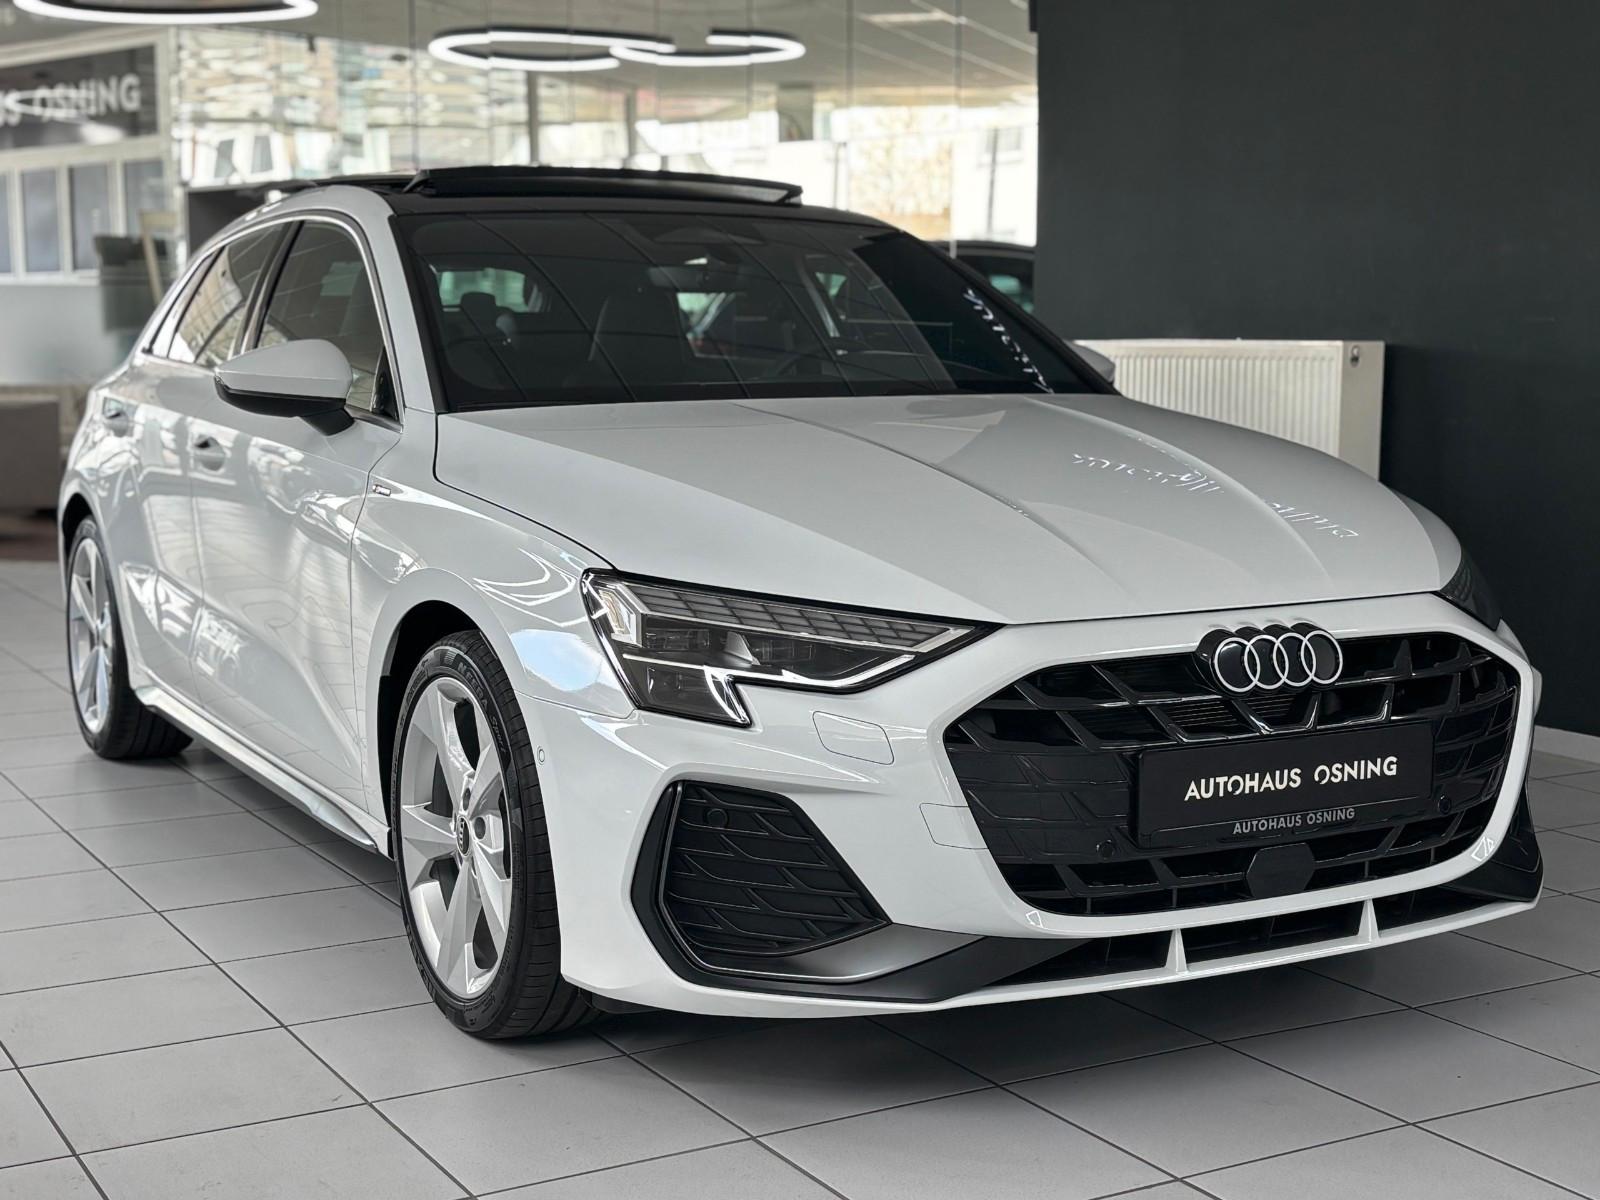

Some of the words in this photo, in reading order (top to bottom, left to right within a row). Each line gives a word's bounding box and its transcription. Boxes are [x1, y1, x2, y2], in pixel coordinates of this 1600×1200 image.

[1184, 767, 1302, 801] AUTOHAUS
[1313, 756, 1398, 785] OSNING
[1233, 814, 1302, 835] AUTOHAUS
[1306, 808, 1356, 825] OSNING
